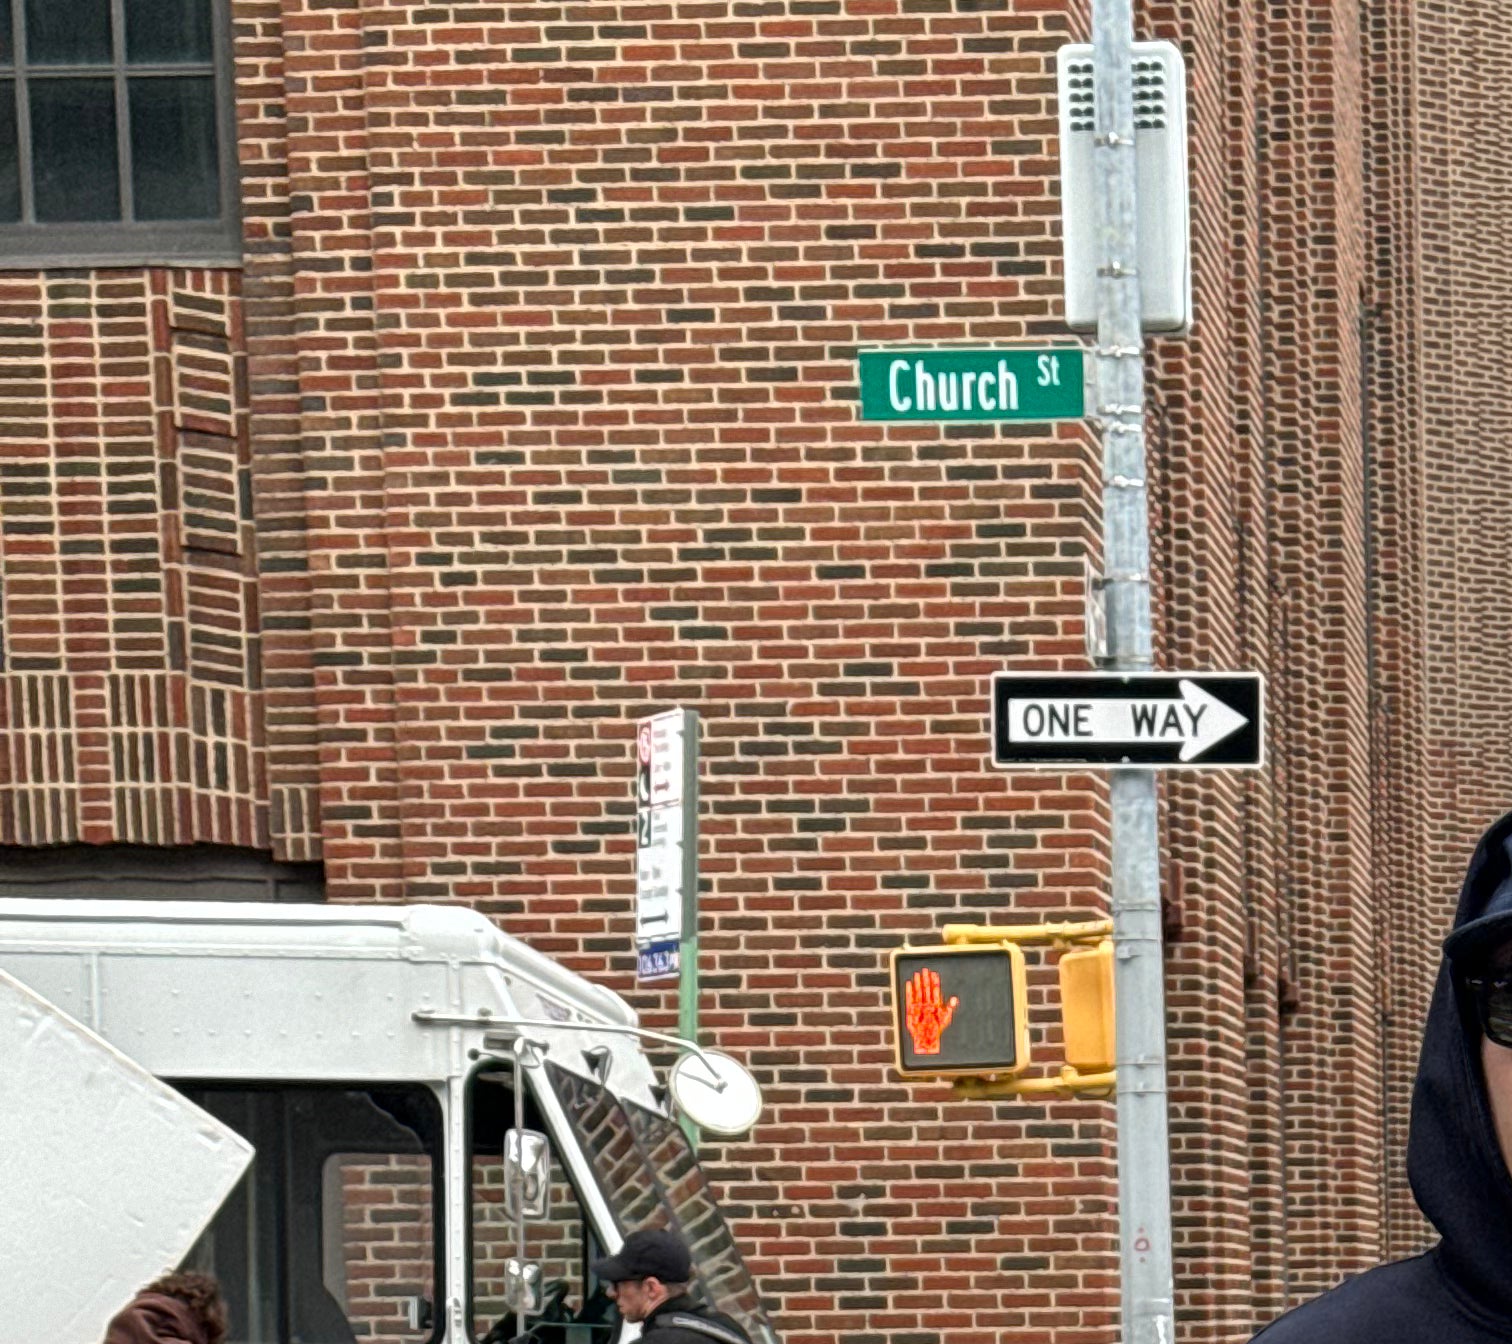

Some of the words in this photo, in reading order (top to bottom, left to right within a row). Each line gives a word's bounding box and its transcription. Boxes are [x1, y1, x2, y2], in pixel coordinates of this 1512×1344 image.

[889, 359, 1019, 411] Church
[1037, 354, 1060, 386] St
[1023, 703, 1093, 737] ONE
[1131, 703, 1208, 737] WAY
